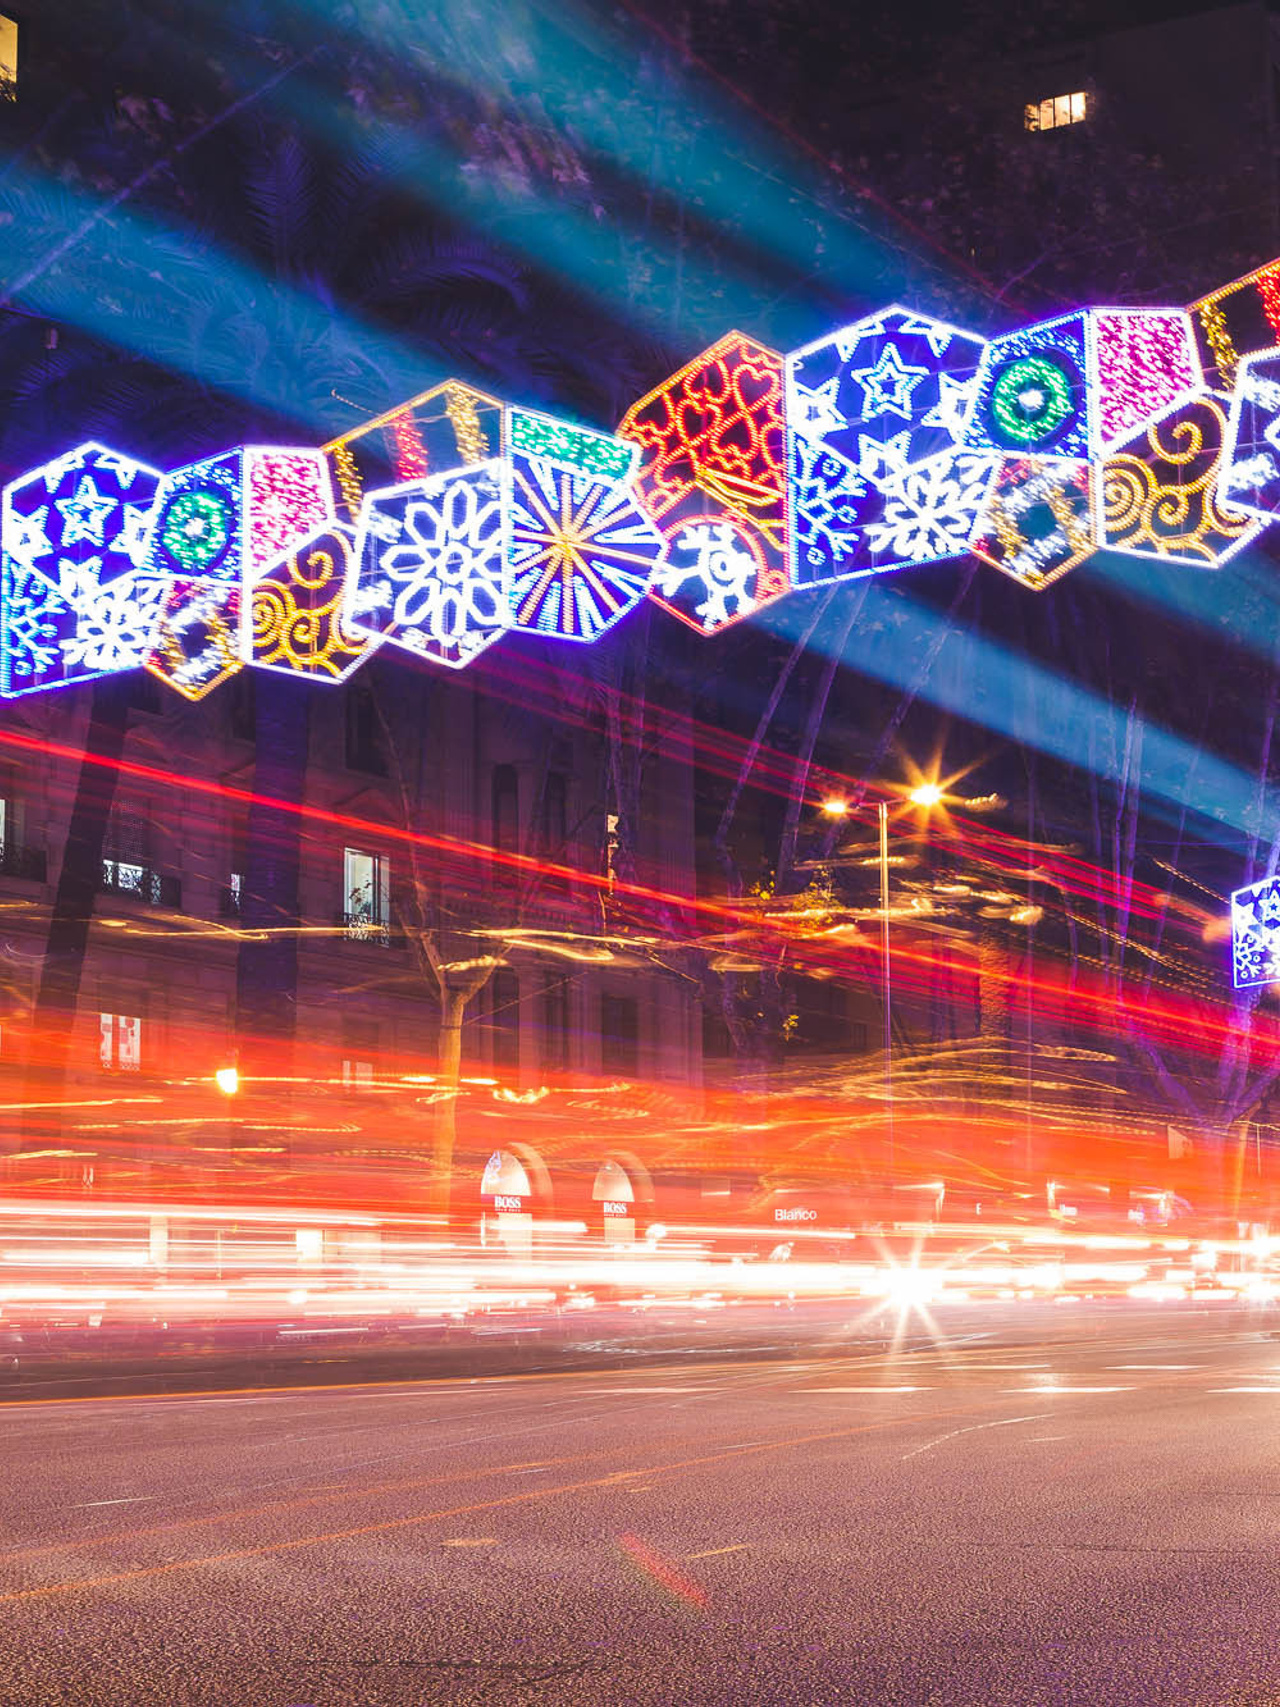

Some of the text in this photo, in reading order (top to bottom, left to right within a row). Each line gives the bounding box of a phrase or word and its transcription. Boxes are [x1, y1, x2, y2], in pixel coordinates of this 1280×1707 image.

[494, 1195, 521, 1208] BOSS
[603, 1202, 627, 1213] BOSS
[774, 1209, 817, 1220] Blanco
